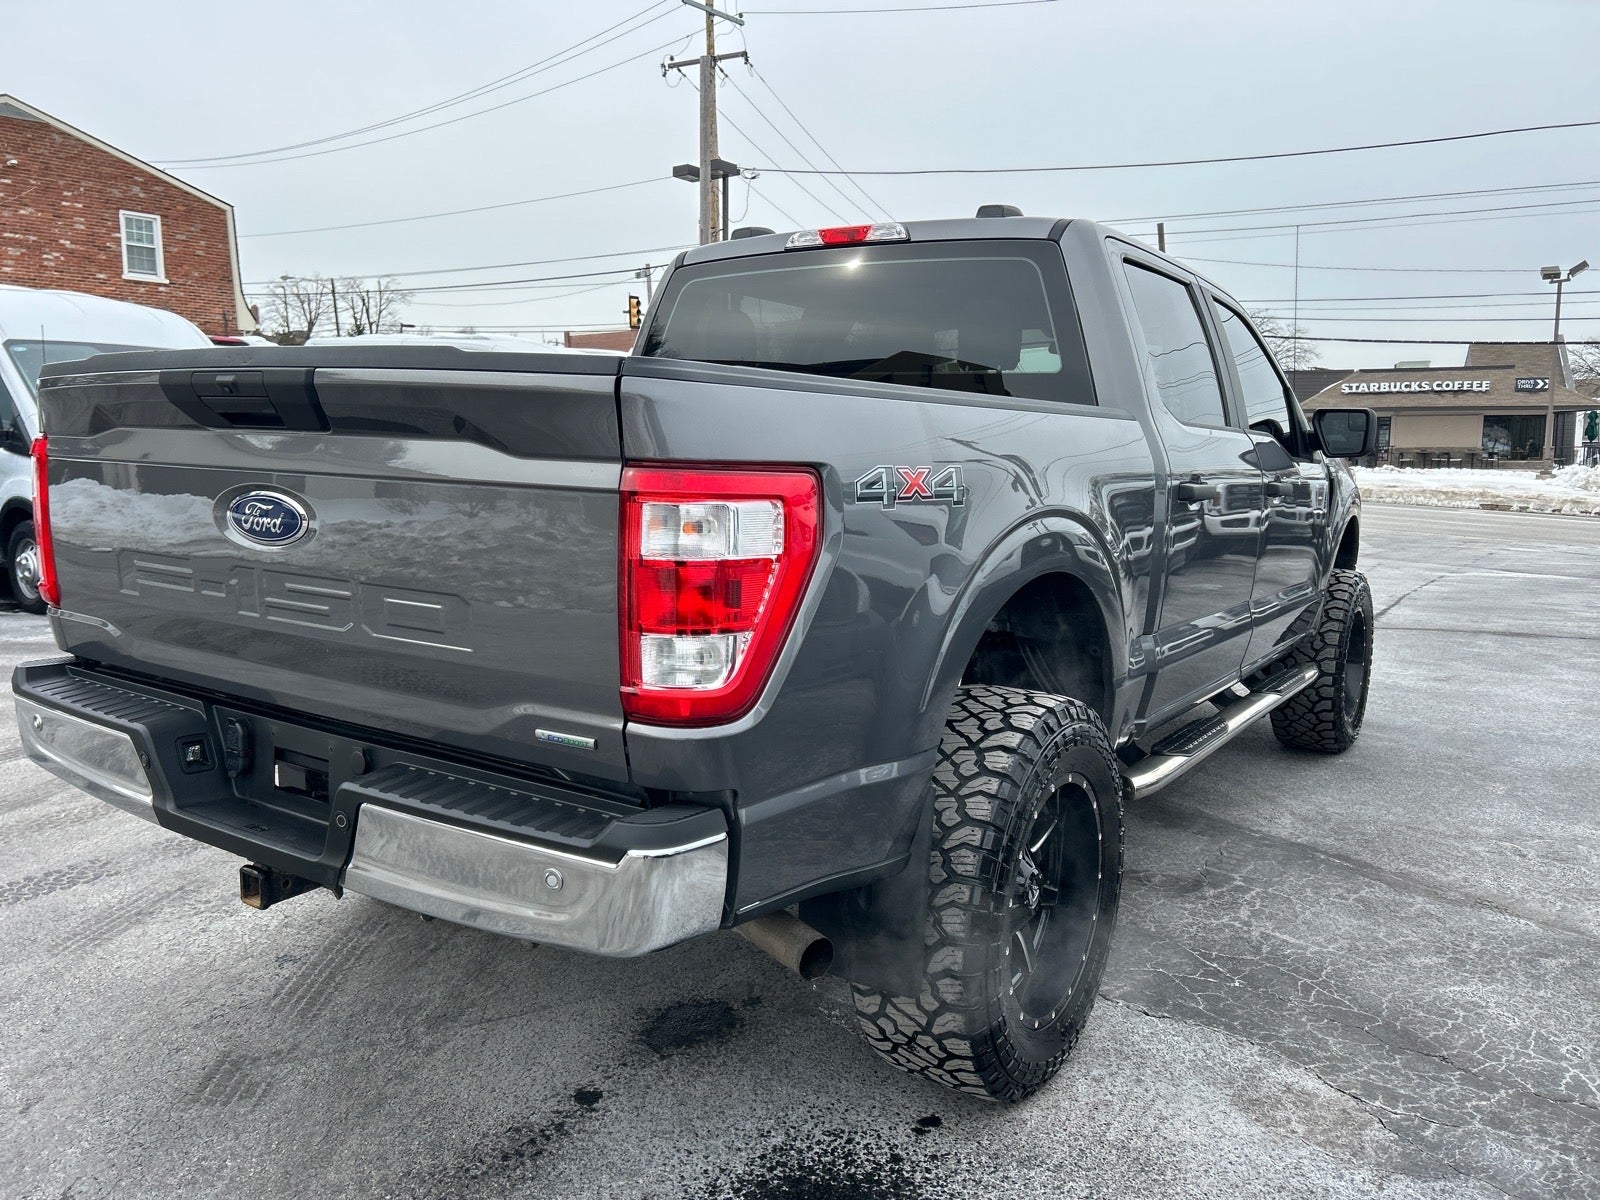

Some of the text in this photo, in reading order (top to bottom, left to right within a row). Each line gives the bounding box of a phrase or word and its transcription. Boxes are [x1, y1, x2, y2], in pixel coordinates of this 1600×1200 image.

[1341, 380, 1490, 394] STARBUCKS COFFEE
[241, 501, 285, 534] Ford
[118, 550, 473, 652] F-150
